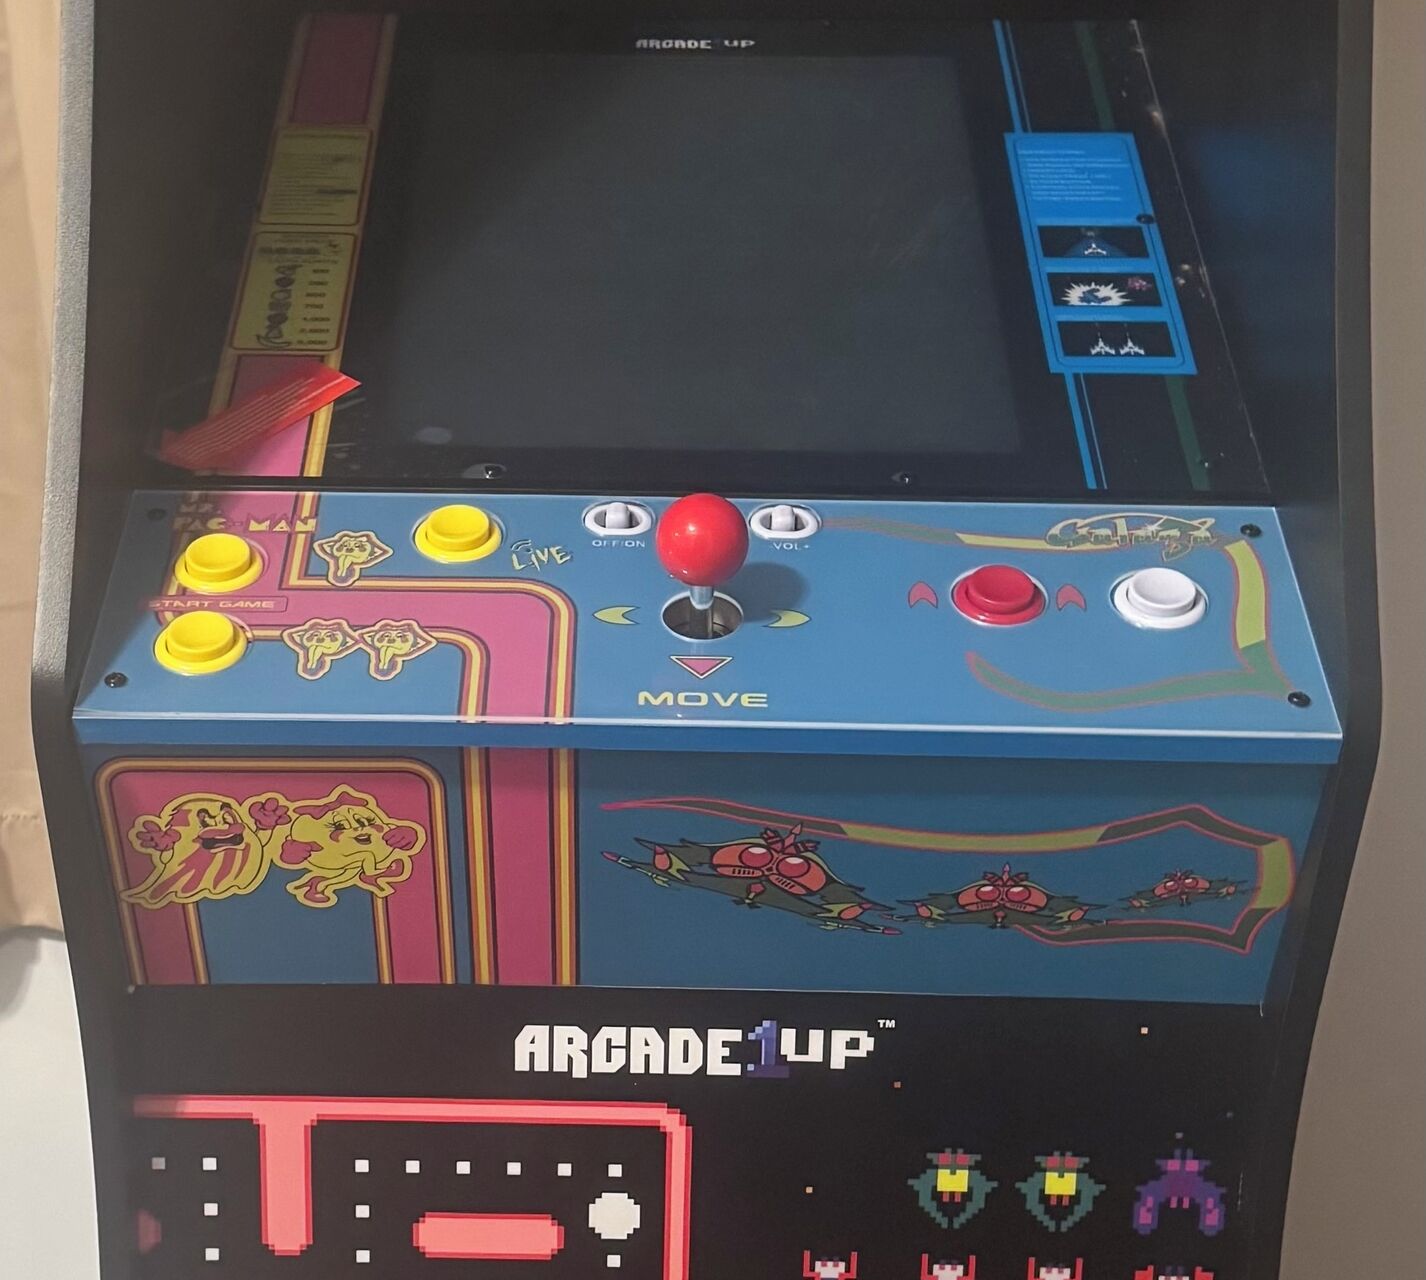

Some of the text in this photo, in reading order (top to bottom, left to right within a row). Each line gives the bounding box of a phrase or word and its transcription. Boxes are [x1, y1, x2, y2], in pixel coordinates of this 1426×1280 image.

[148, 599, 276, 610] START GAME
[637, 690, 769, 708] MOVE
